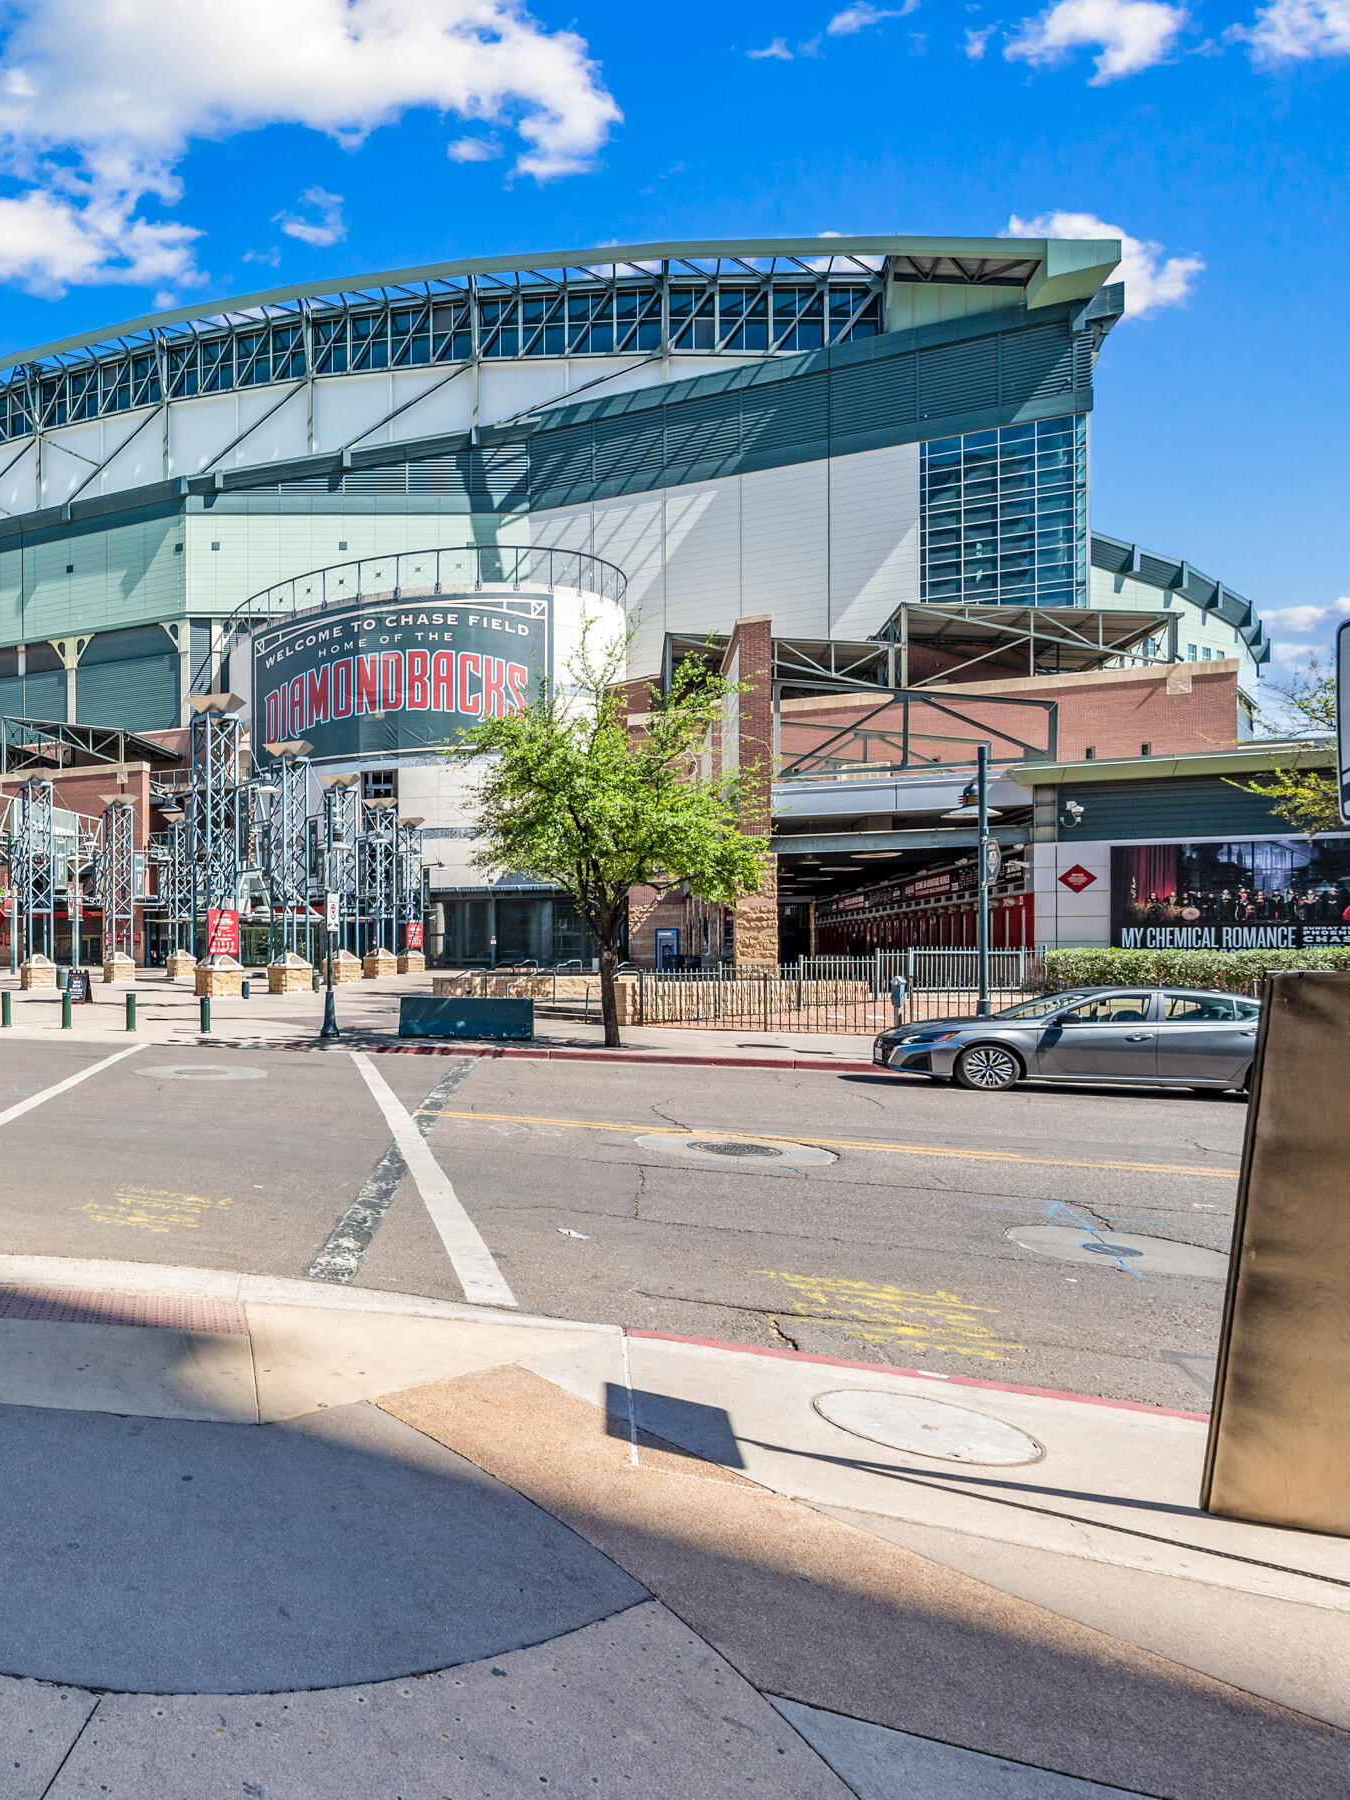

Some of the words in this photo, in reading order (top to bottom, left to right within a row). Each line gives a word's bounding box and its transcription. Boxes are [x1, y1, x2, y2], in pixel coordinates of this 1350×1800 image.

[265, 625, 343, 669] WELCOME
[350, 619, 375, 633] TO
[385, 613, 459, 628] CHASE
[468, 614, 530, 637] FIELD
[318, 638, 367, 658] HOME
[379, 632, 403, 644] OF
[415, 631, 453, 642] THE
[264, 648, 528, 745] DIAMONDBACKS
[1121, 927, 1144, 948] MY
[1146, 926, 1218, 948] CHEMICAL
[1221, 926, 1297, 948] ROMANCE
